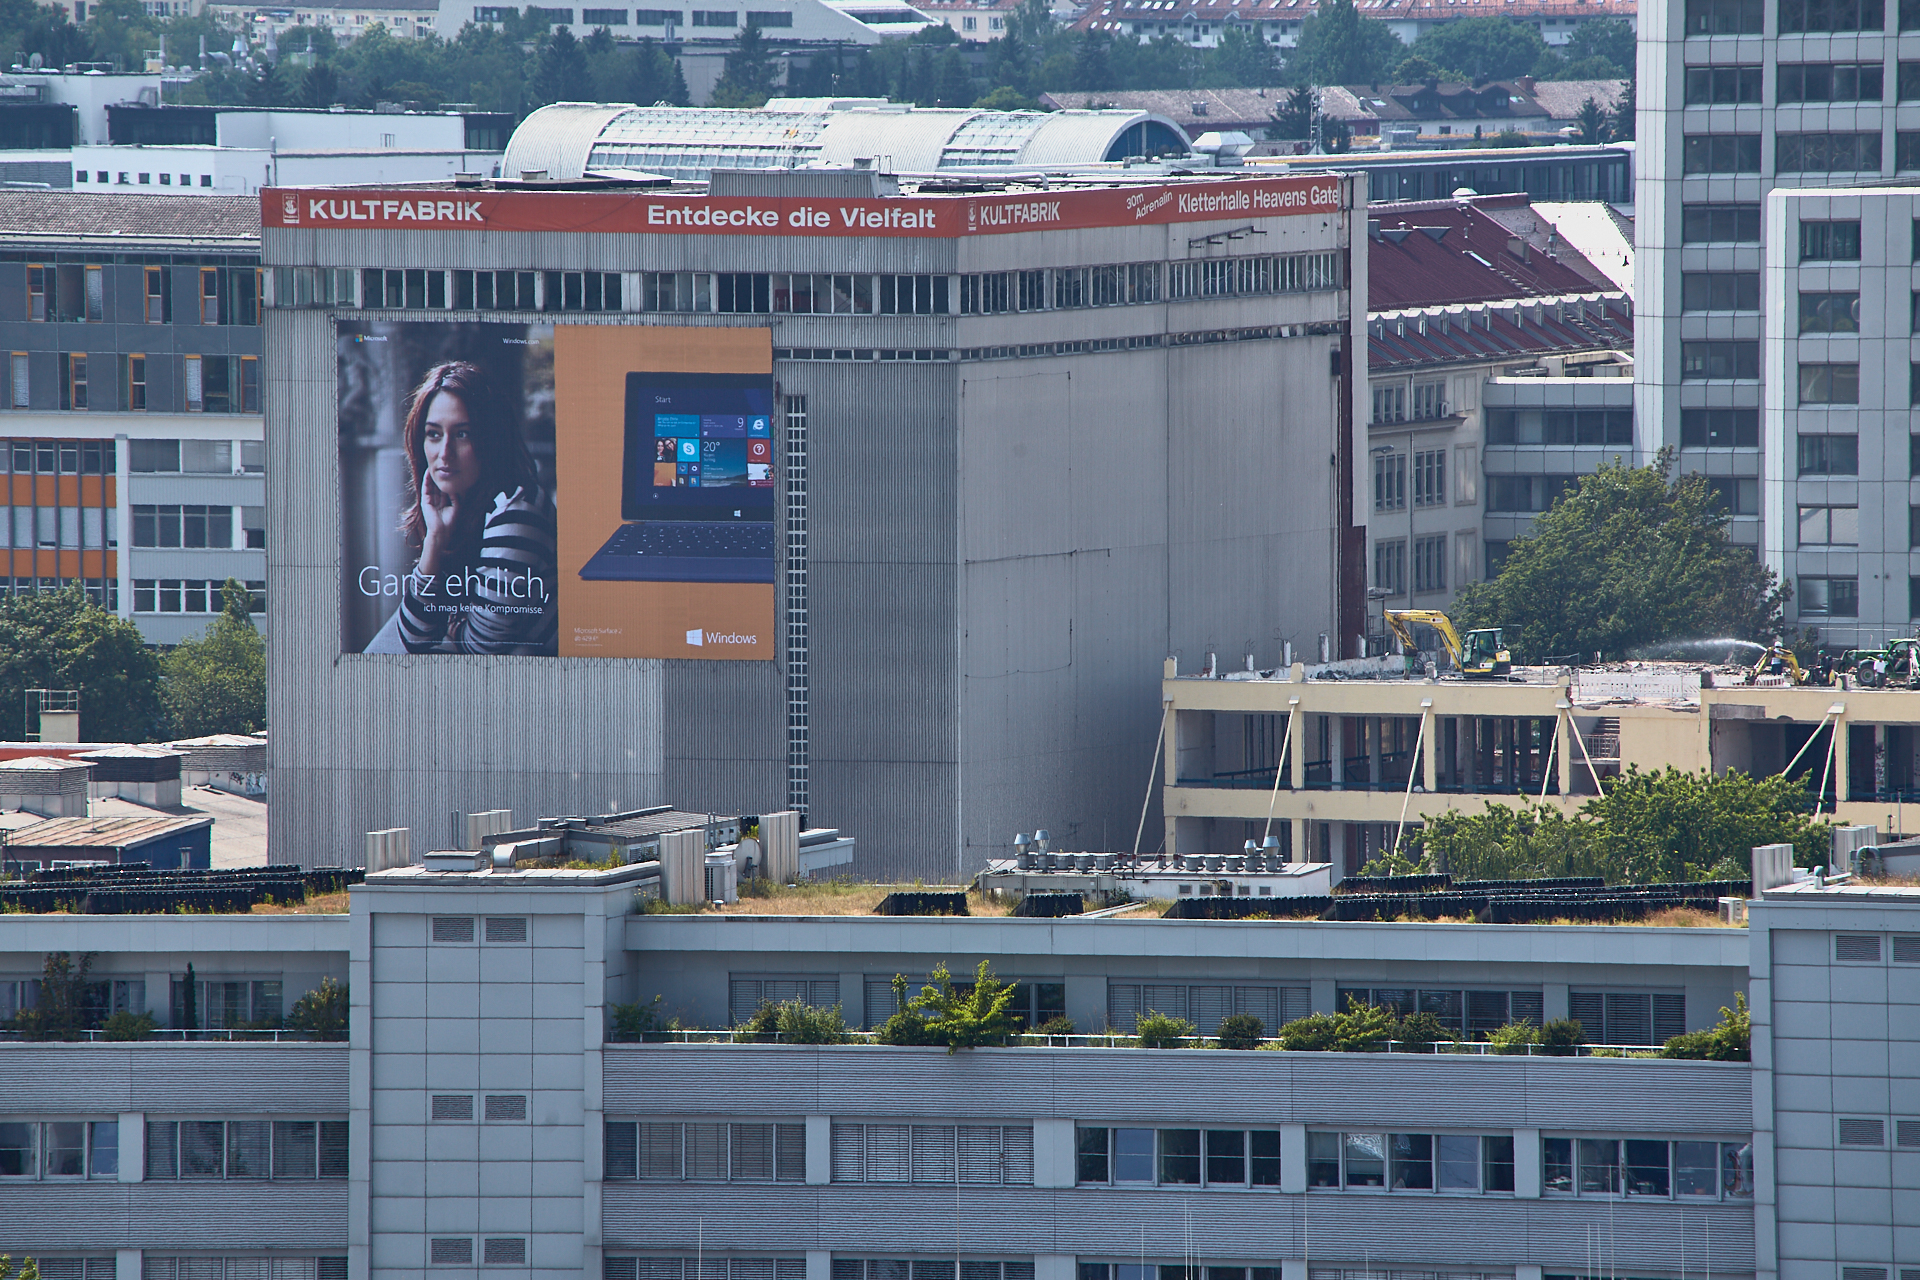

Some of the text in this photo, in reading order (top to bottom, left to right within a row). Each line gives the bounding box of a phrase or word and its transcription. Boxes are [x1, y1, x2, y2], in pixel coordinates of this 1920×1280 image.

[309, 199, 484, 222] KULTFABRIK
[1126, 193, 1144, 210] 30m
[1135, 191, 1173, 220] Adrenalin
[1178, 185, 1338, 214] Kletterhalle Heavens Gate
[647, 205, 936, 229] Entdecke die Vielfalt
[980, 201, 1061, 226] KULTFABRIK
[737, 417, 744, 428] 9
[703, 441, 721, 452] 20°
[358, 565, 550, 603] Ganz ehrlich,
[423, 603, 545, 615] ich mag keine Kompromisse.
[706, 632, 757, 644] Windows
